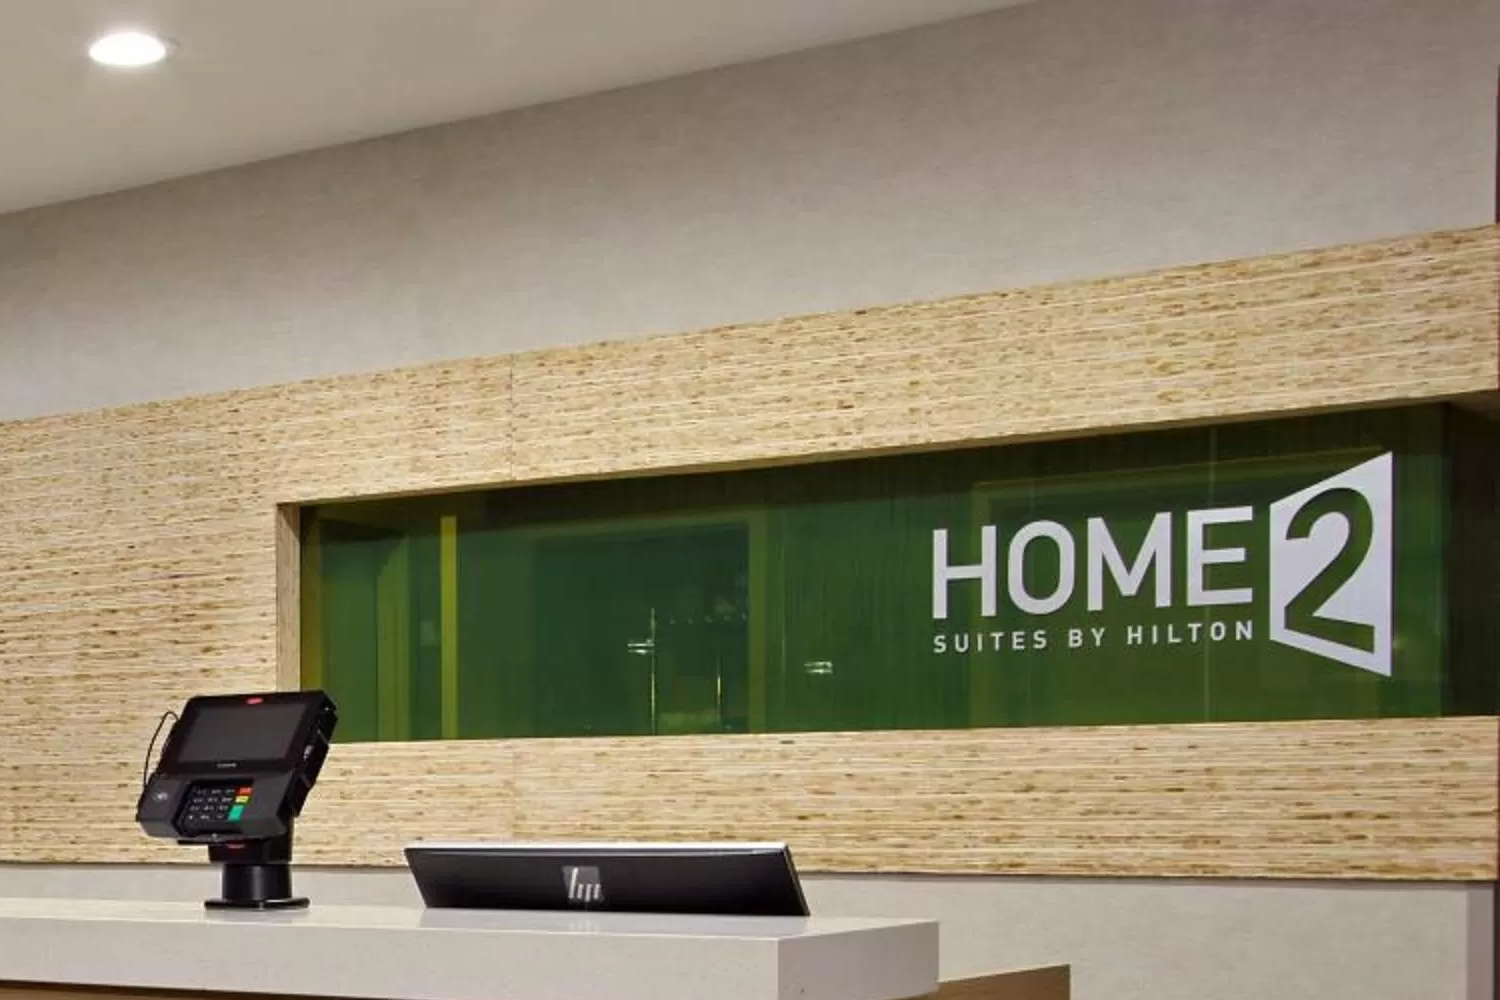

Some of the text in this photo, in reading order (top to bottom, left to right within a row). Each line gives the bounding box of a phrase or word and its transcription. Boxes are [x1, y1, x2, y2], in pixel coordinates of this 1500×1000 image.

[932, 505, 1254, 620] HOME
[933, 619, 1254, 654] SUITES BY HILTON
